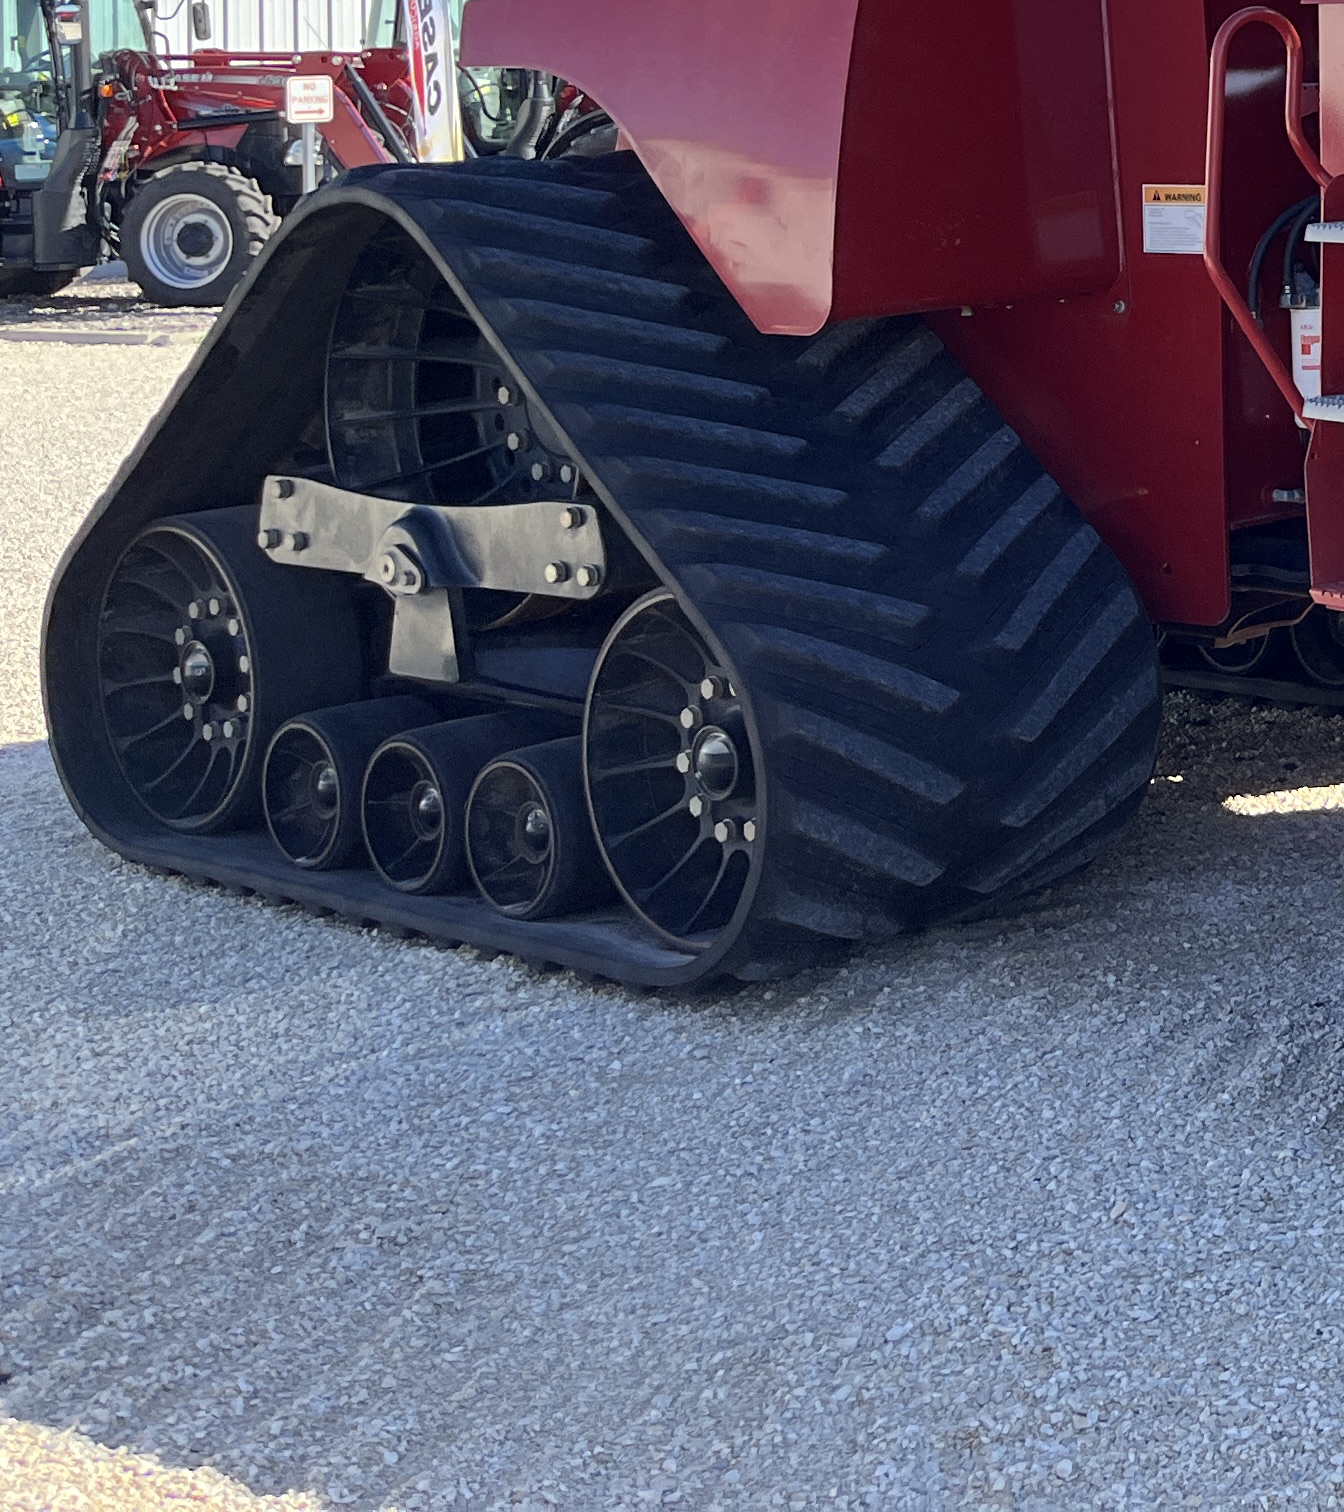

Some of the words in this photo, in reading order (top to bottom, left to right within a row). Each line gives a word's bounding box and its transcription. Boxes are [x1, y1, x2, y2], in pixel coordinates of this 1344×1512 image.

[303, 82, 316, 90] NO
[291, 95, 328, 104] PARKING
[1164, 192, 1202, 202] WARNING
